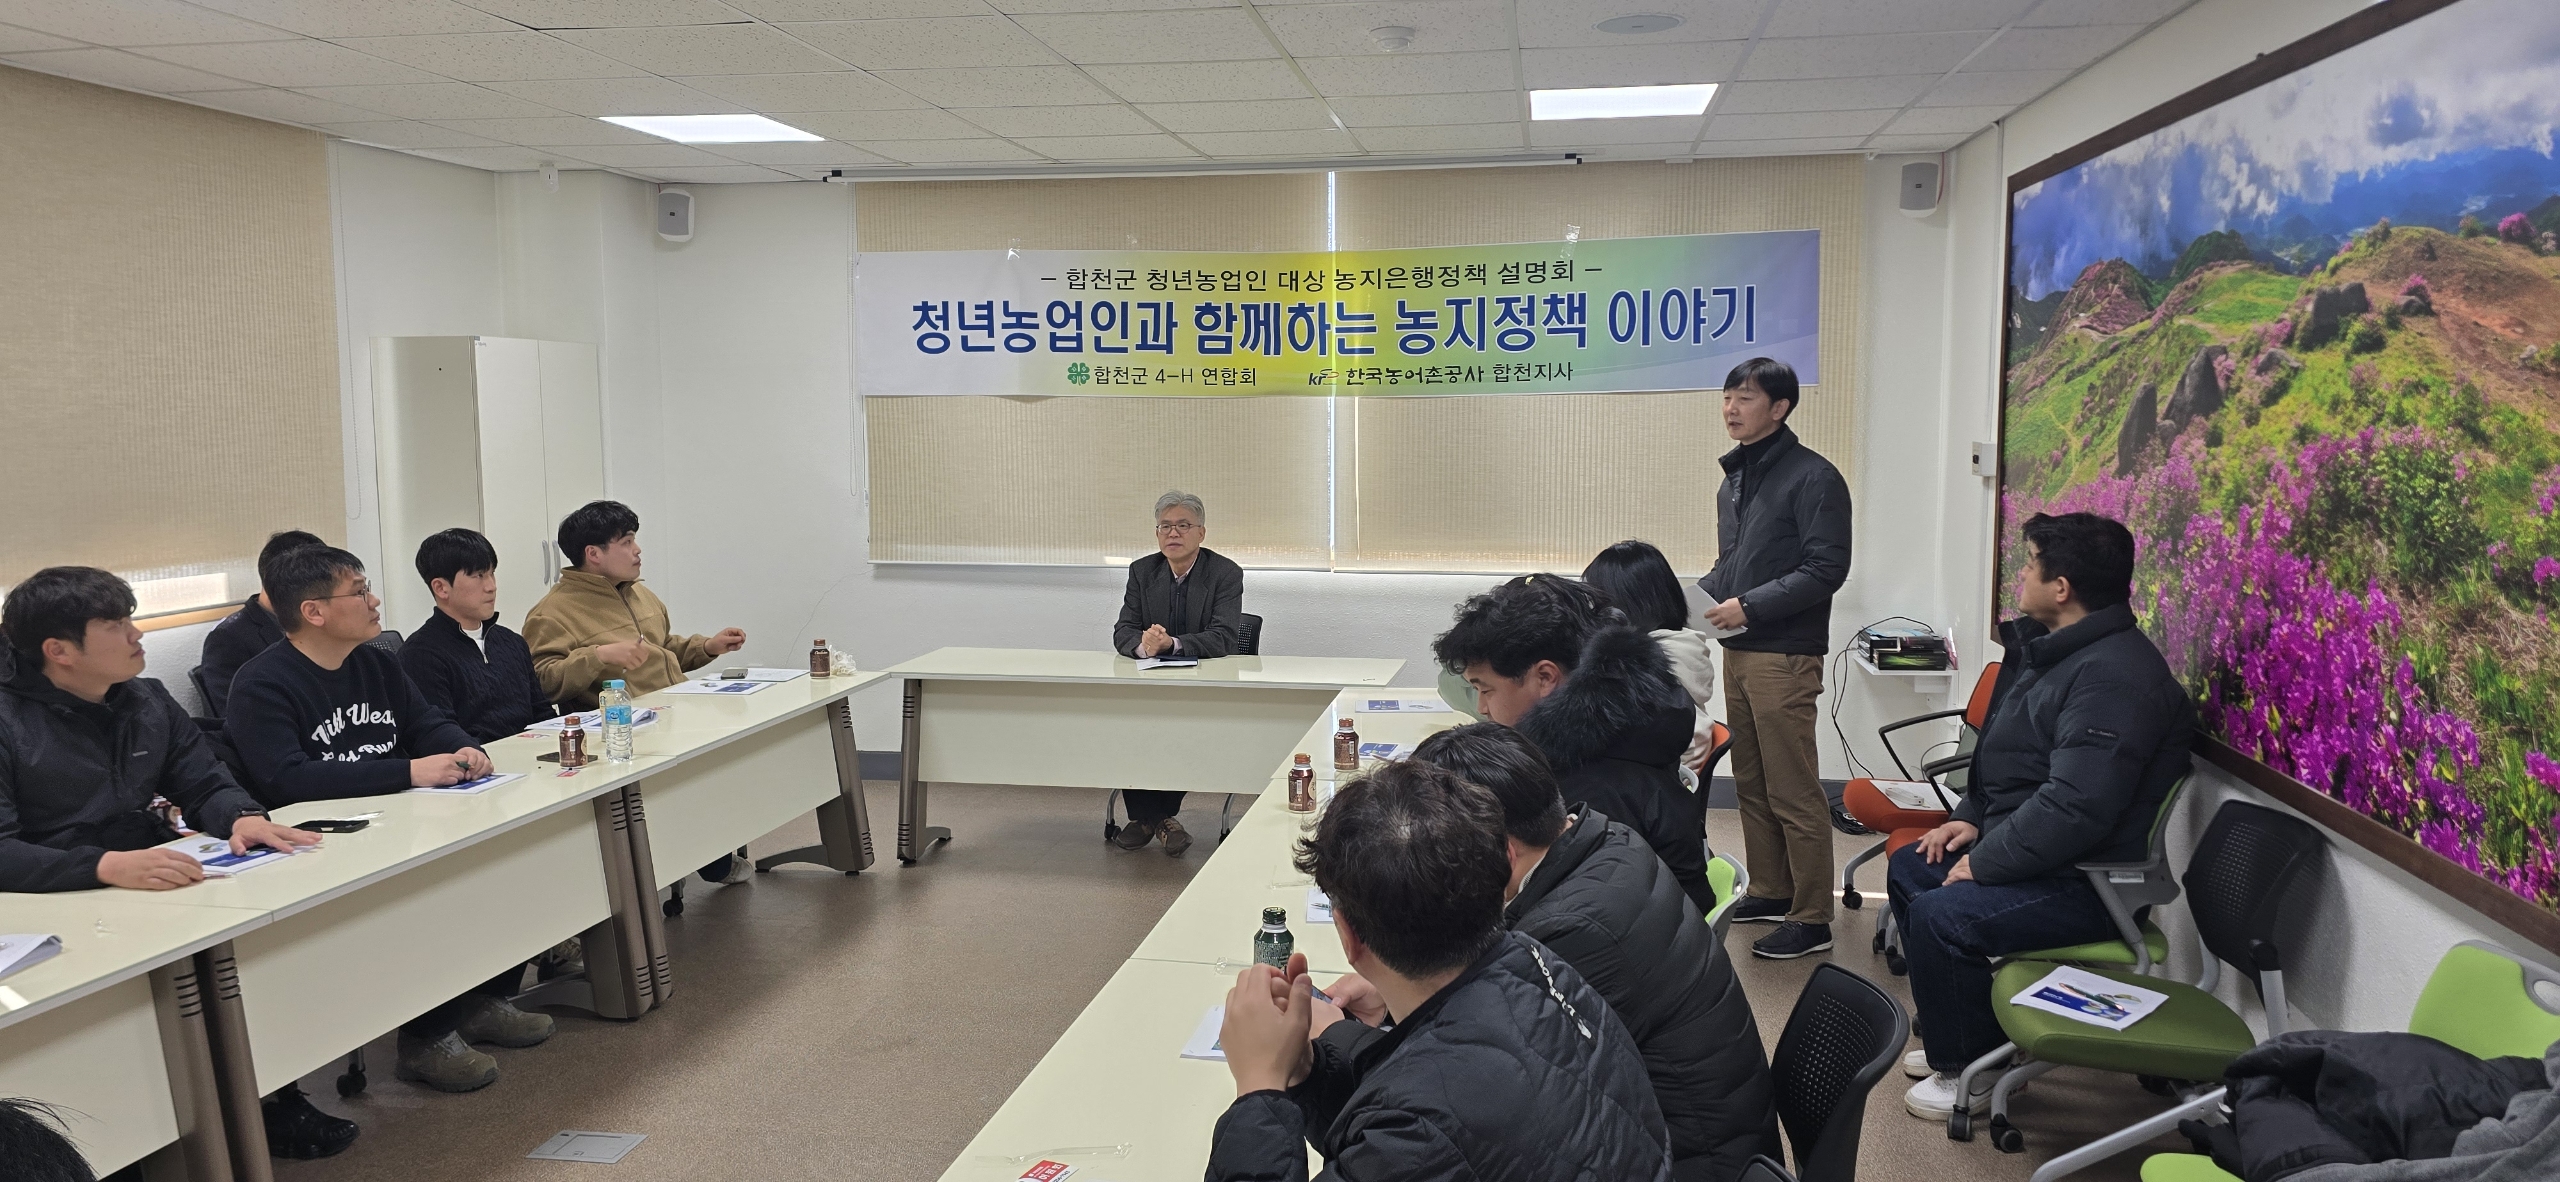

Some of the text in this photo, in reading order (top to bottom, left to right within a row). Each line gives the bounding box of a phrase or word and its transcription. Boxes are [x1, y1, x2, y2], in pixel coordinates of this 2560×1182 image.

[1066, 268, 1137, 291] 합천군
[1146, 269, 1267, 292] 청년농업인
[1278, 270, 1326, 293] 대상
[1333, 263, 1487, 291] 농지은행정책
[1497, 259, 1574, 285] 설명회
[912, 285, 1755, 356] 청년농업인과 함께하는 농지정책 이야기
[1094, 366, 1149, 386] 합천군
[1201, 367, 1257, 387] 연합회
[1345, 361, 1574, 386] 한국농어촌공사 합천지사
